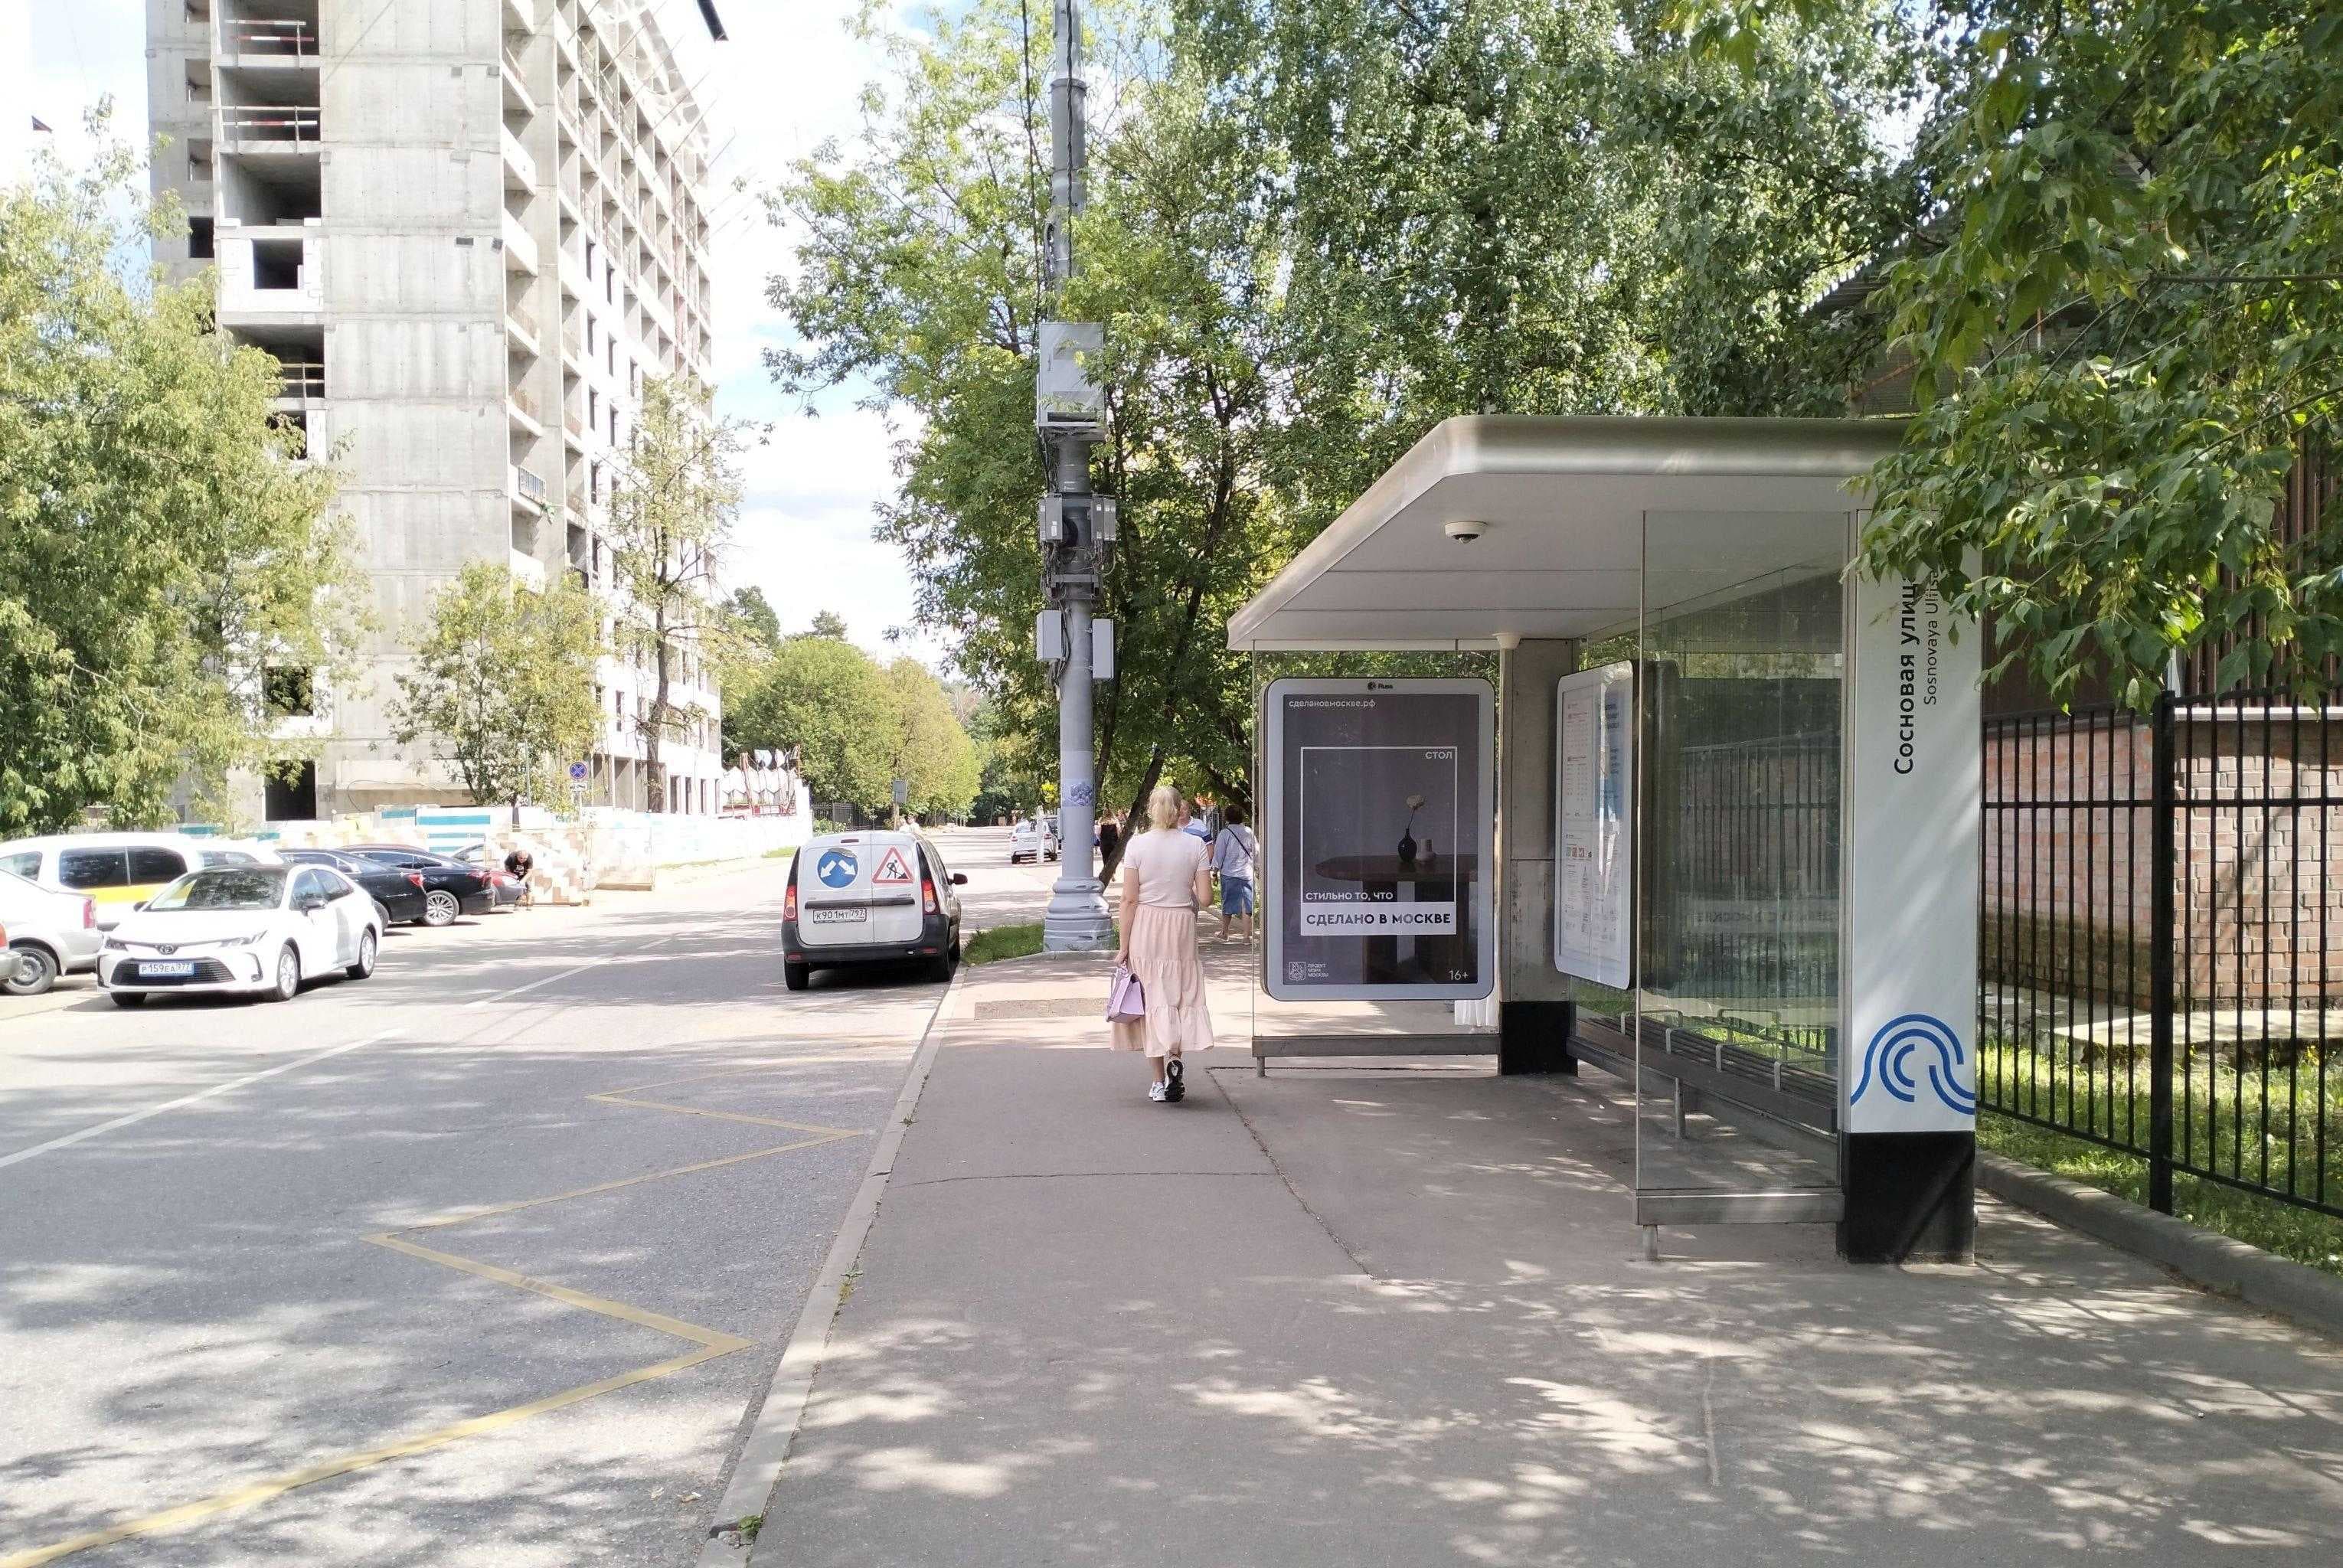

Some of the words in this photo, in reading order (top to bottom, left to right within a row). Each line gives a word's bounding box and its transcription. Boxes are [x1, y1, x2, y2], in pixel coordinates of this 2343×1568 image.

[1900, 577, 1920, 645] улиц
[1923, 620, 1941, 705] Sosnovaya
[1289, 698, 1376, 708] сделановмоскве.рф
[1894, 655, 1914, 775] Сосновая
[1425, 751, 1453, 760] СТОЛ
[1305, 891, 1353, 900] СТИЛЬНО
[1355, 891, 1371, 902] ТО,
[1373, 891, 1394, 900] ЧТО
[1306, 914, 1375, 926] СДЕЛАНО
[1379, 913, 1387, 924] В
[1392, 913, 1451, 924] МОСКВЕ
[1449, 969, 1469, 980] 16+
